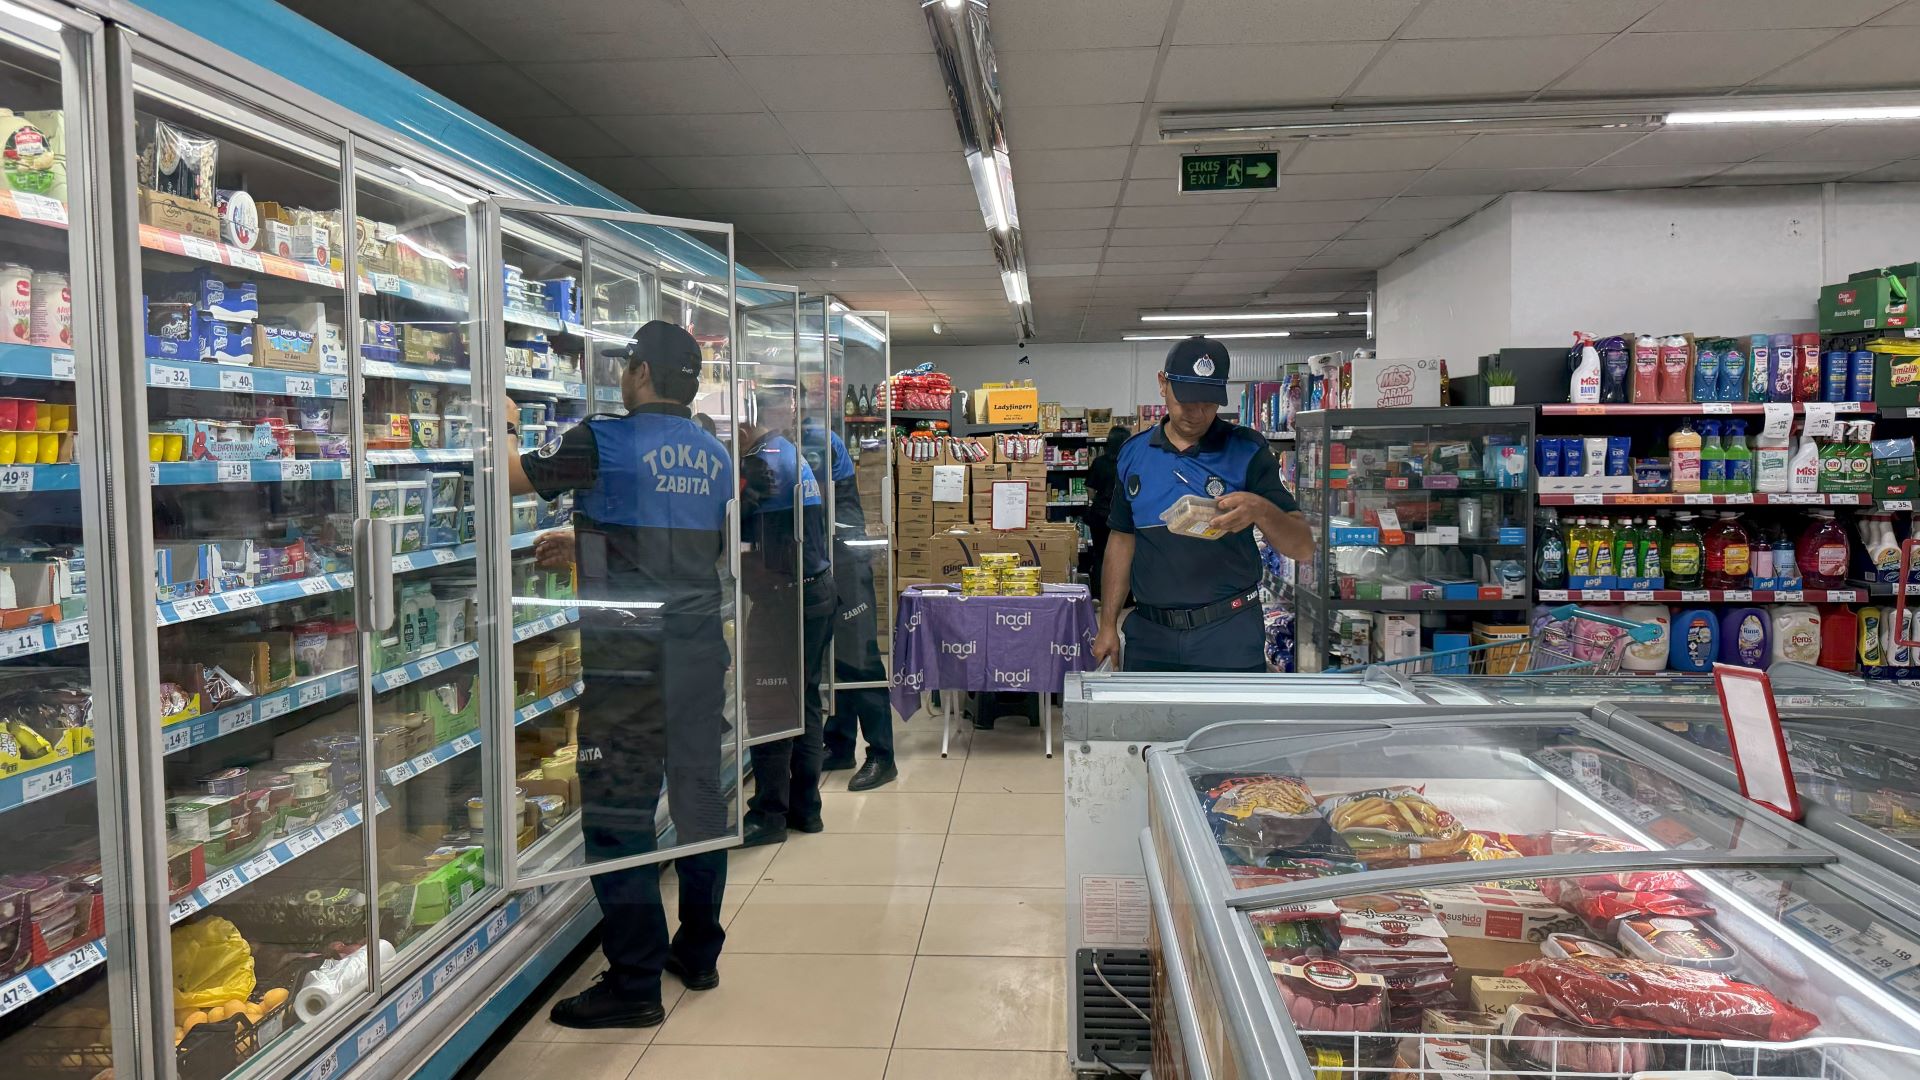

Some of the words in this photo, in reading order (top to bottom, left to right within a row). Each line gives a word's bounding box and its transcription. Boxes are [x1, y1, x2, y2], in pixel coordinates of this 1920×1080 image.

[1187, 161, 1220, 173] ÇIKIŞ
[1190, 174, 1219, 185] EXIT
[173, 371, 185, 382] 32
[1384, 388, 1408, 399] ARAP
[994, 403, 1033, 411] Ladyfingers
[1377, 395, 1413, 408] SABUNU
[642, 443, 723, 481] TOKAT
[655, 475, 710, 496] ZABITA
[1543, 551, 1561, 560] OMO
[842, 602, 869, 621] ZABITA
[996, 611, 1032, 626] hadi
[1791, 635, 1813, 643] Peros
[942, 641, 977, 655] hadi
[1050, 641, 1081, 657] hadi
[755, 677, 788, 686] ZABITA
[995, 669, 1030, 683] hadi
[1446, 912, 1482, 923] sushida
[70, 943, 93, 964] 27,50
[1891, 948, 1912, 961] 159
[1871, 956, 1893, 968] 159
[3, 982, 28, 1004] 47,50
